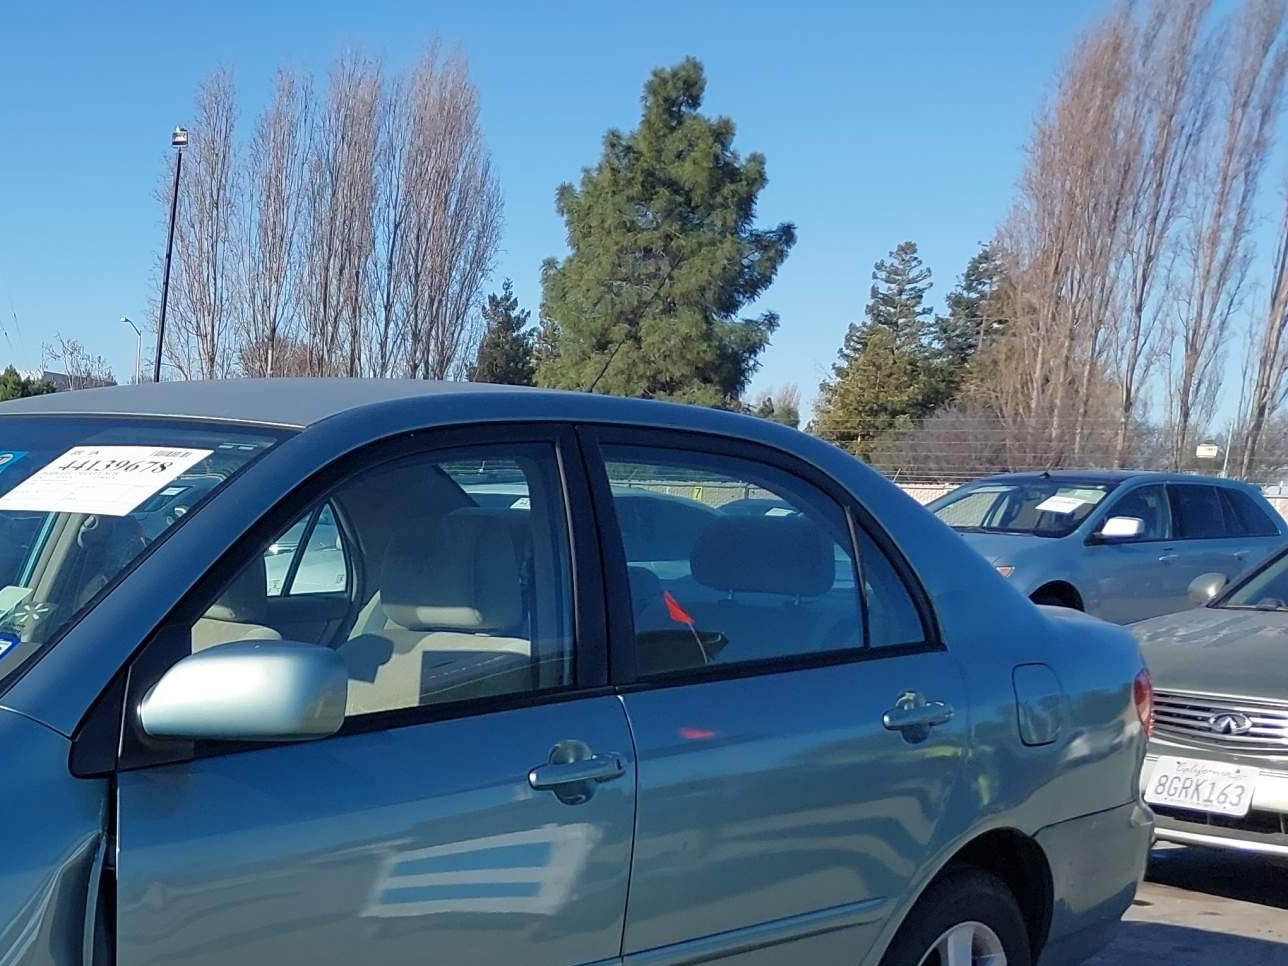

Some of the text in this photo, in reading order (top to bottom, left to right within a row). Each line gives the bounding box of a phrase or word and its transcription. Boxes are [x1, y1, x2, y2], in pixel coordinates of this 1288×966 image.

[58, 459, 174, 473] 44139678
[695, 487, 702, 498] 7
[1154, 774, 1245, 807] 8GRK163
